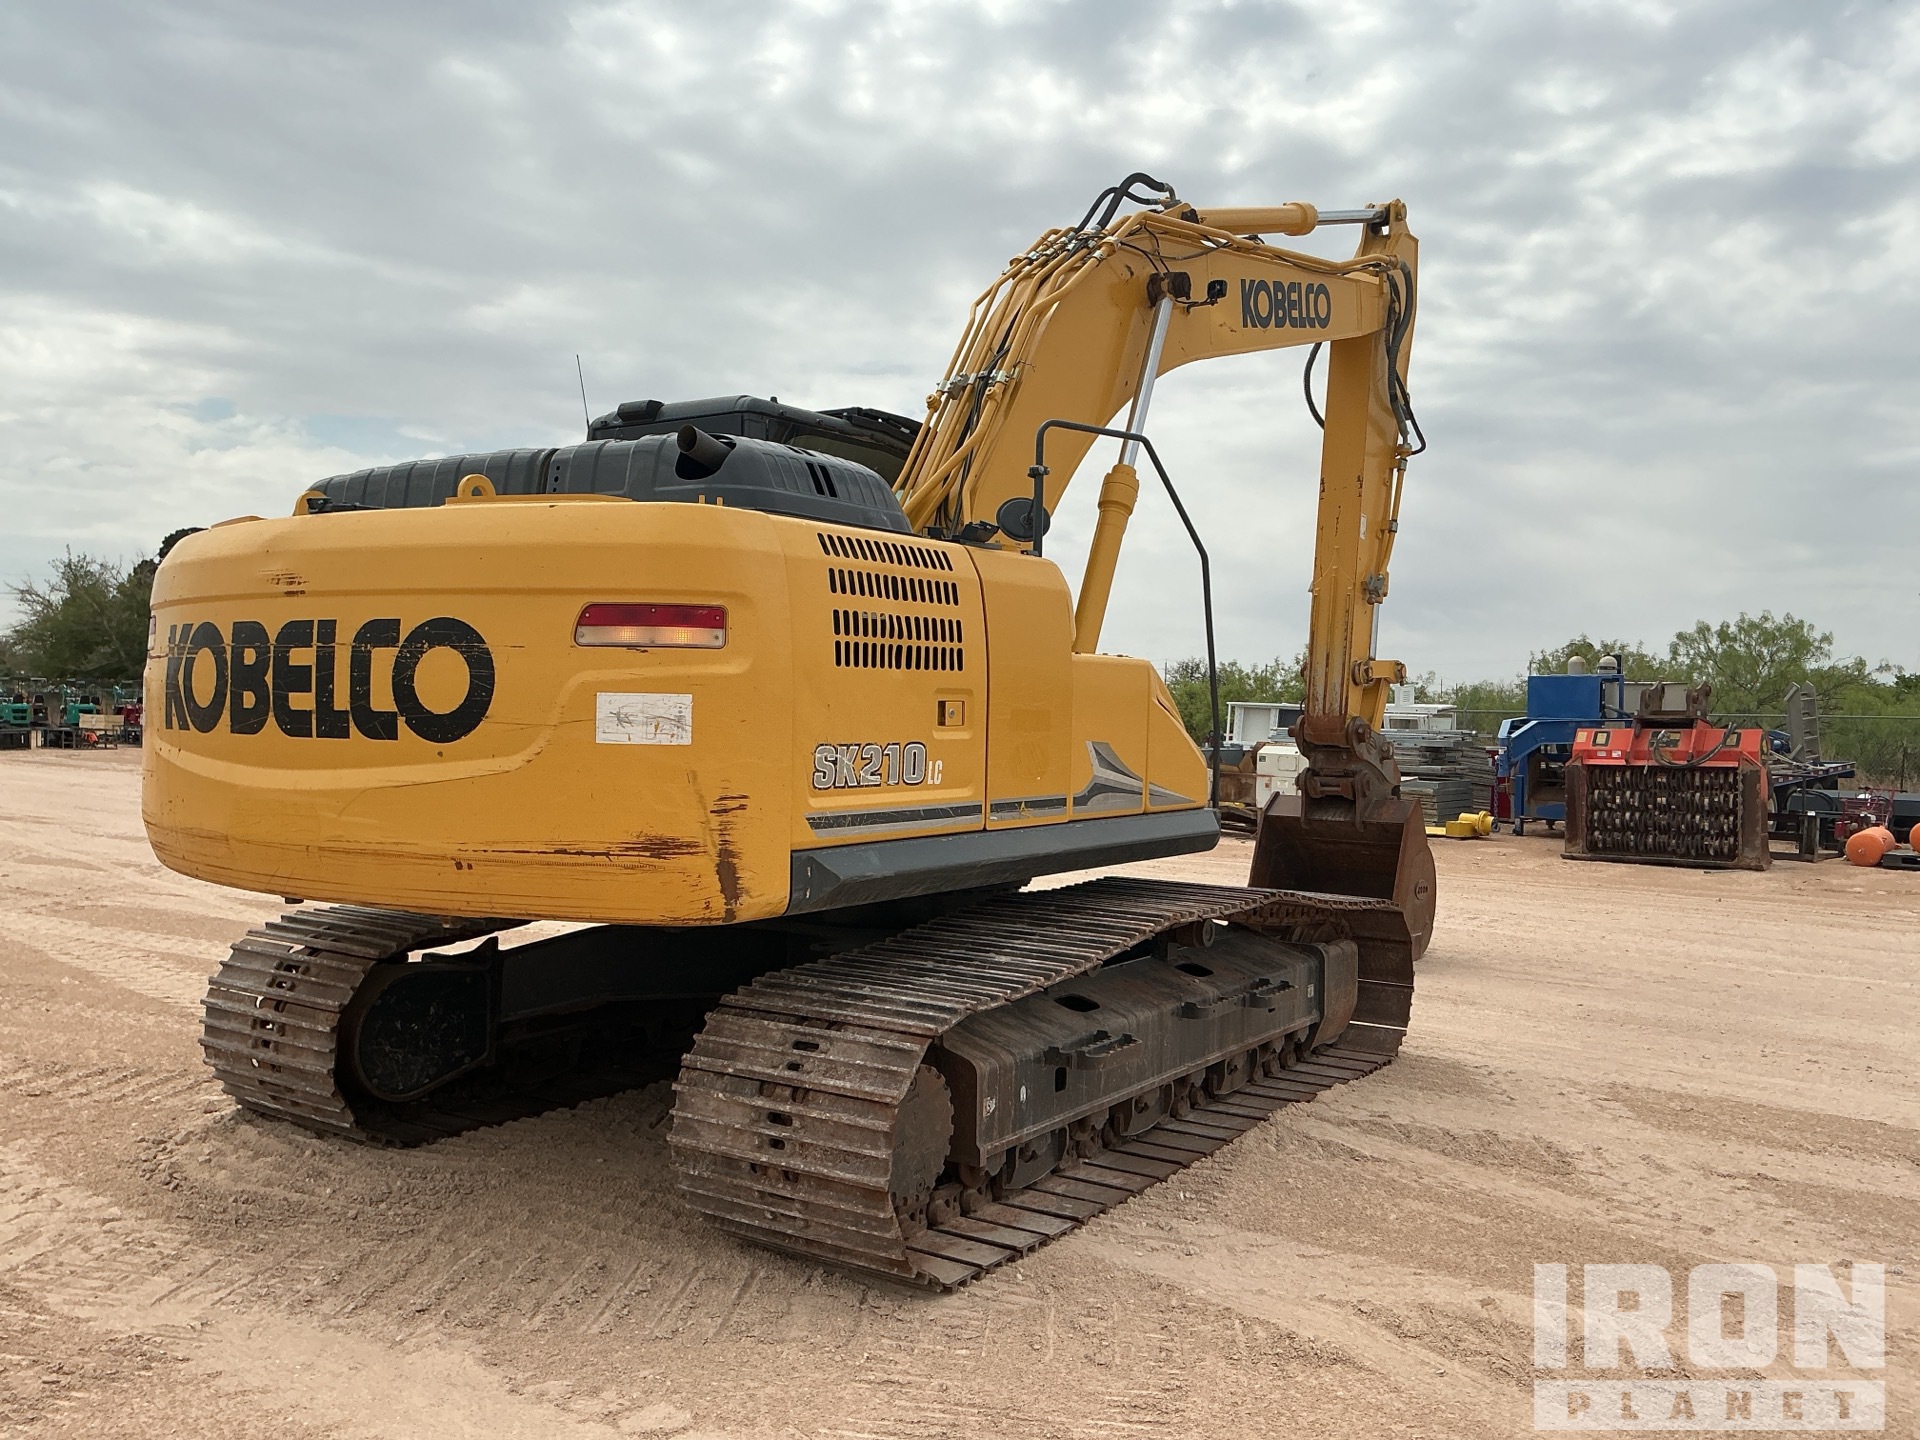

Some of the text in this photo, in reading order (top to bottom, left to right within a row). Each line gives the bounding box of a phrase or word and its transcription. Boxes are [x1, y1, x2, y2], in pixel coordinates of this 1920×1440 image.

[1241, 279, 1331, 329] KOBELCO
[165, 617, 495, 743] KOBELCO
[813, 741, 943, 790] SK210 LC
